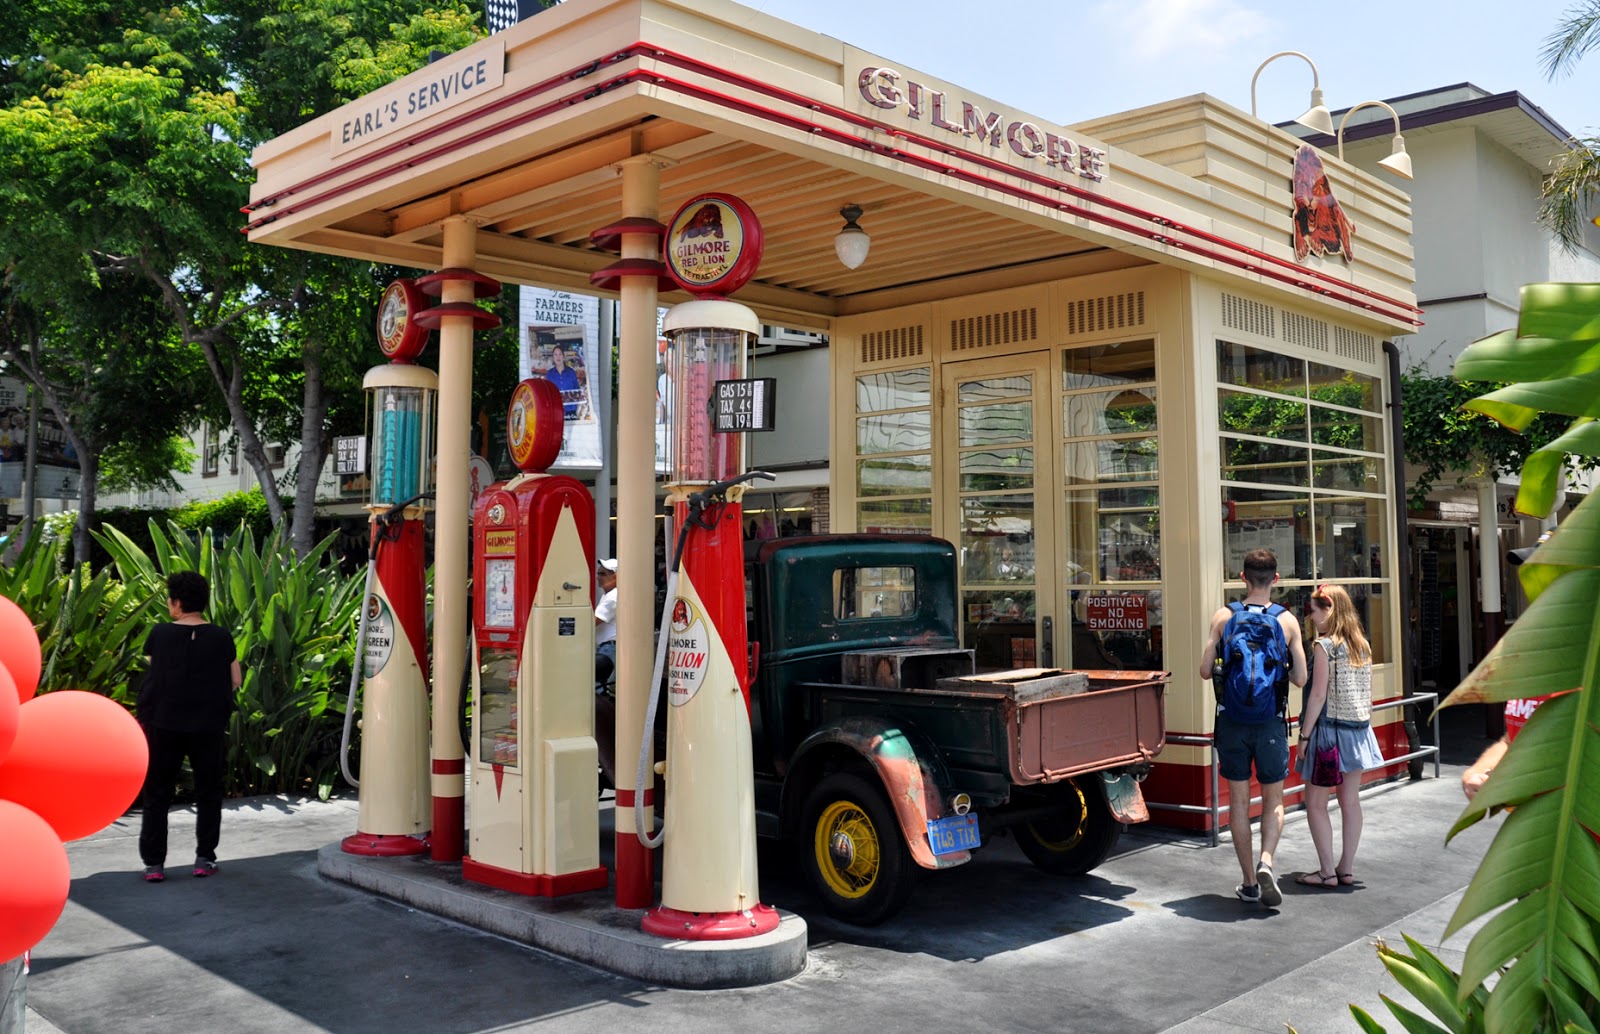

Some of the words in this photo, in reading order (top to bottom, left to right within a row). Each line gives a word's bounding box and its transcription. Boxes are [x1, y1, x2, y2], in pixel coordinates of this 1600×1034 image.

[342, 100, 399, 144] EARL'S
[407, 59, 487, 115] SERVICE
[858, 67, 1106, 183] GILMORE
[677, 240, 731, 258] GILMORE
[682, 257, 698, 268] RED
[703, 254, 725, 265] LION
[535, 297, 584, 313] FARMERS
[720, 384, 735, 398] GAS
[737, 383, 746, 397] 15
[720, 399, 734, 414] TAX
[719, 414, 734, 429] TOTAL
[736, 414, 746, 429] 19
[337, 439, 347, 450] GAS
[337, 450, 347, 461] TAX
[1087, 597, 1145, 608] POSITIVELY
[1108, 608, 1124, 618] NO
[1090, 618, 1144, 629] SMOKING
[671, 638, 697, 649] LMORE
[675, 651, 706, 669] LION
[670, 670, 695, 680] SOLINE
